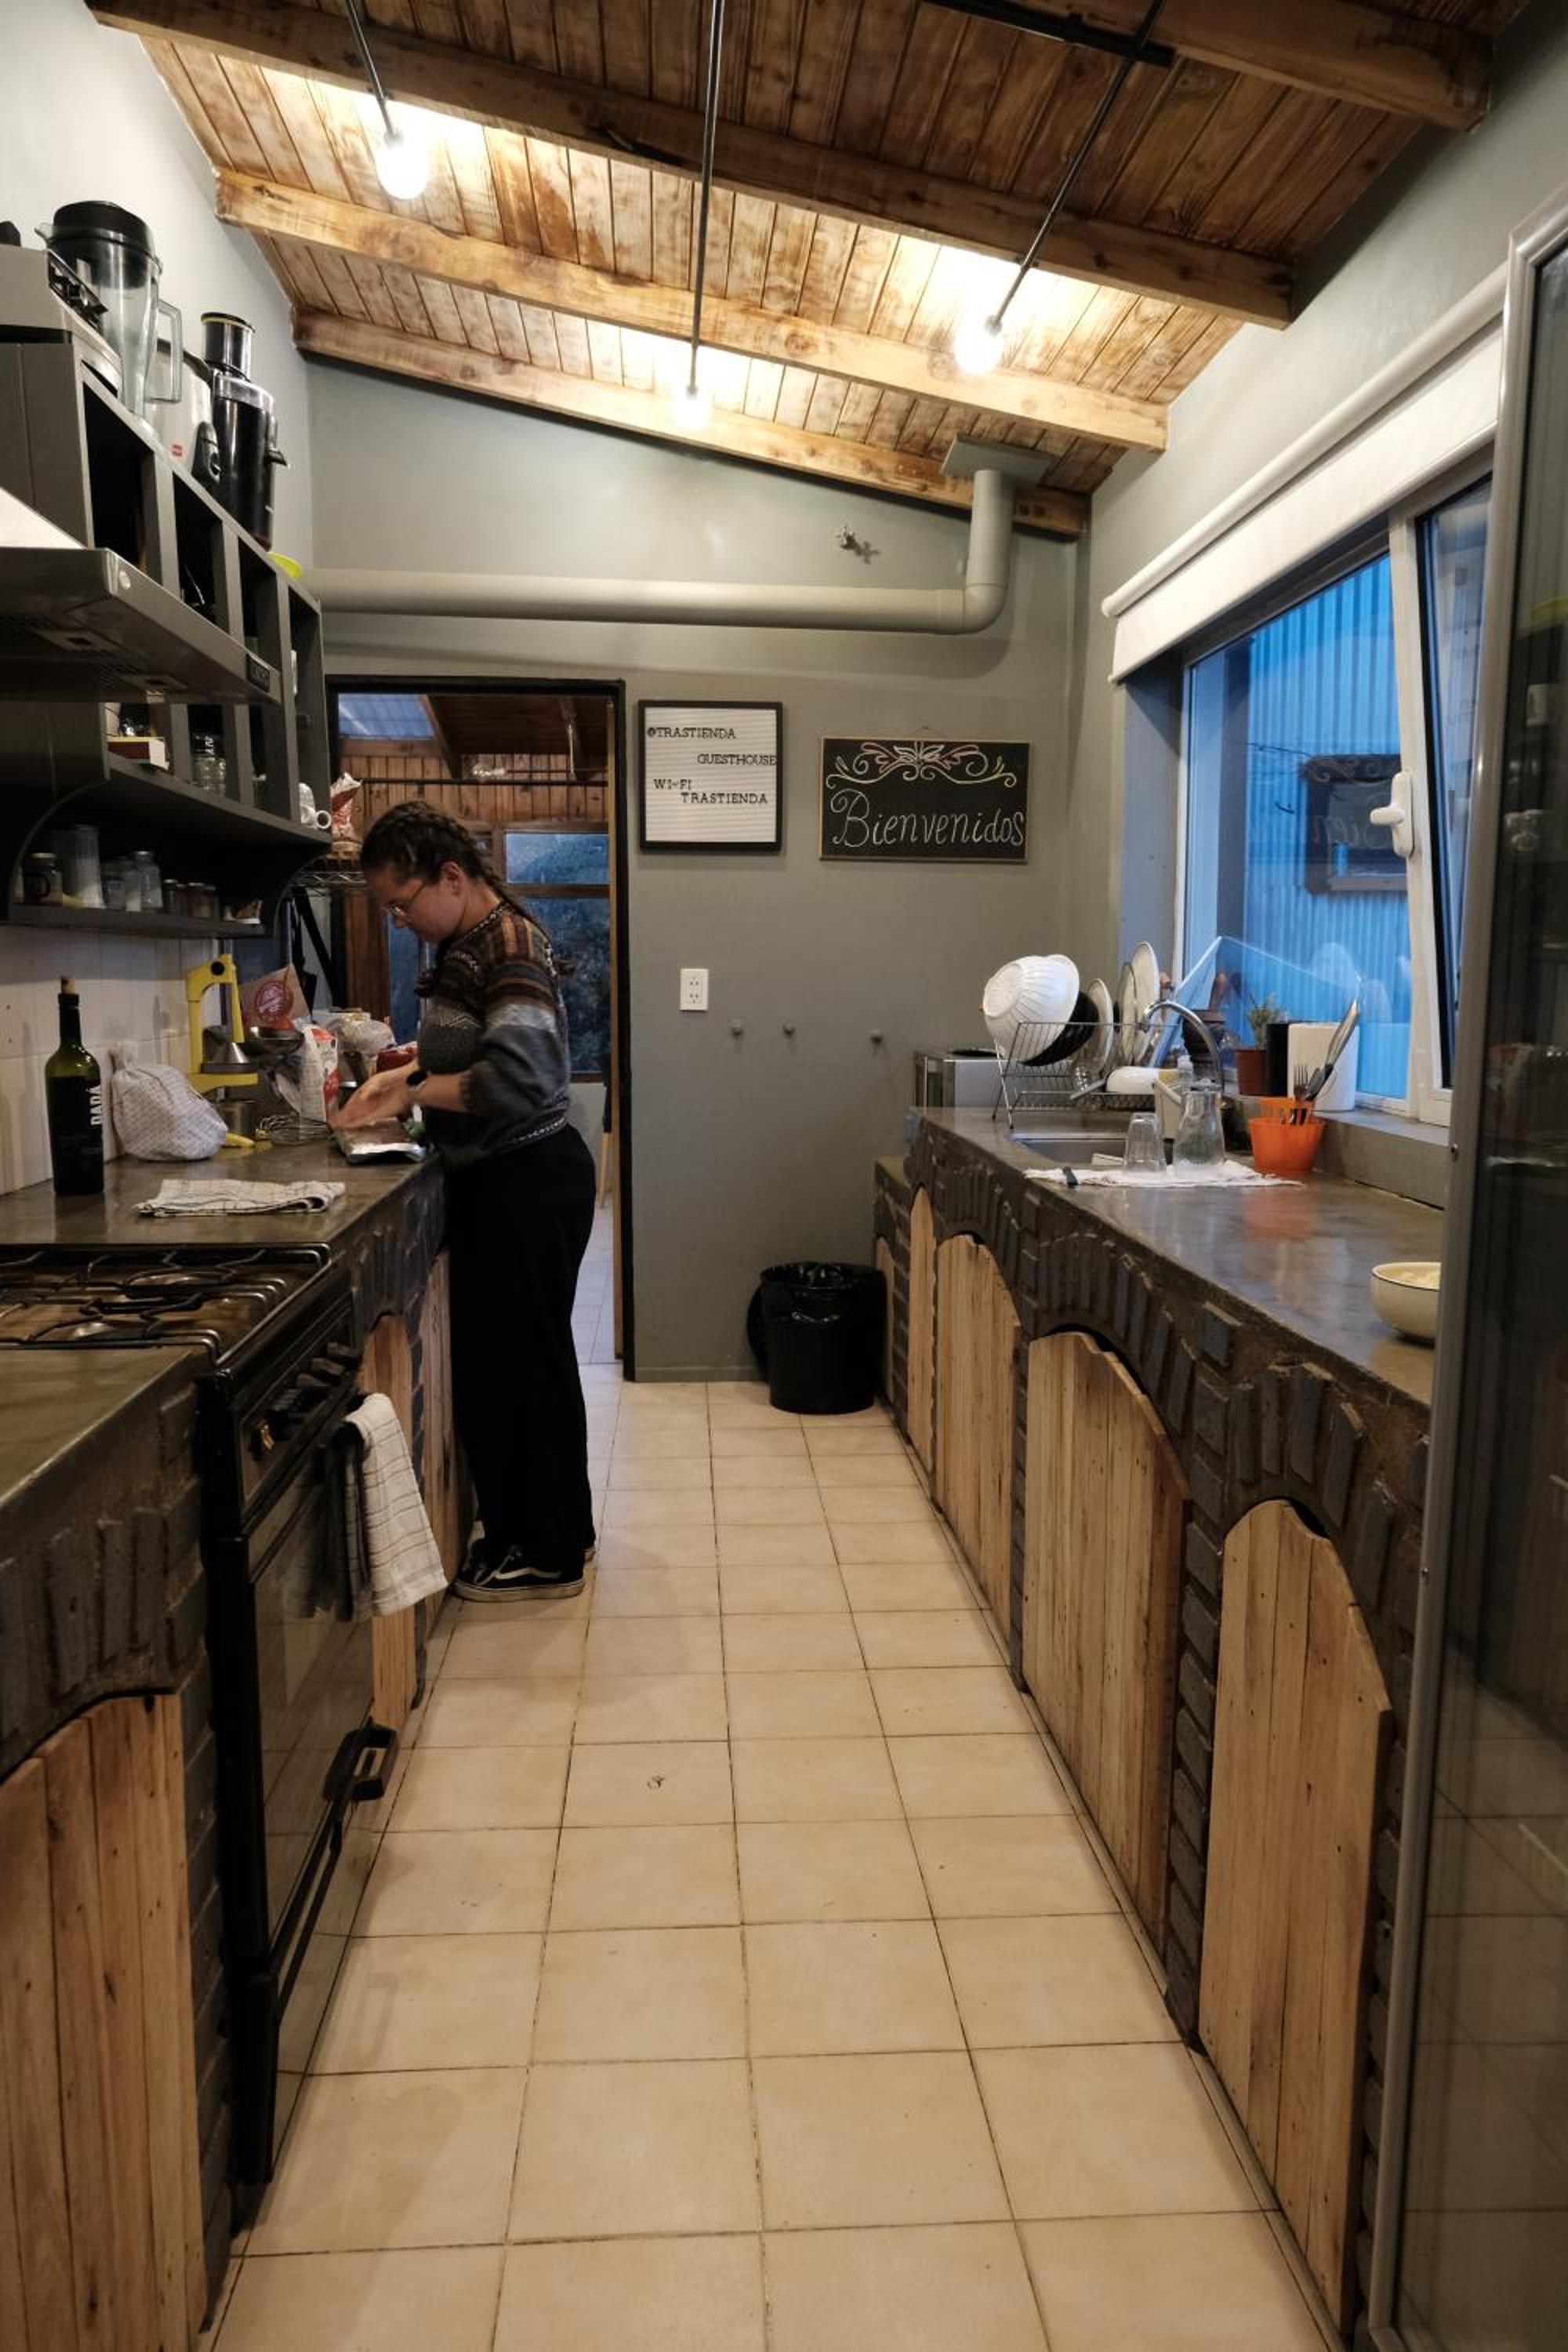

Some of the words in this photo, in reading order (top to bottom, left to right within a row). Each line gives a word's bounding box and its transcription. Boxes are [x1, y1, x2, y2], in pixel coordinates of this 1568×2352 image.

[697, 753, 778, 765] GUESTHOUSE
[681, 792, 768, 804] TRASTIENDA
[829, 788, 1024, 848] Bienvenidos
